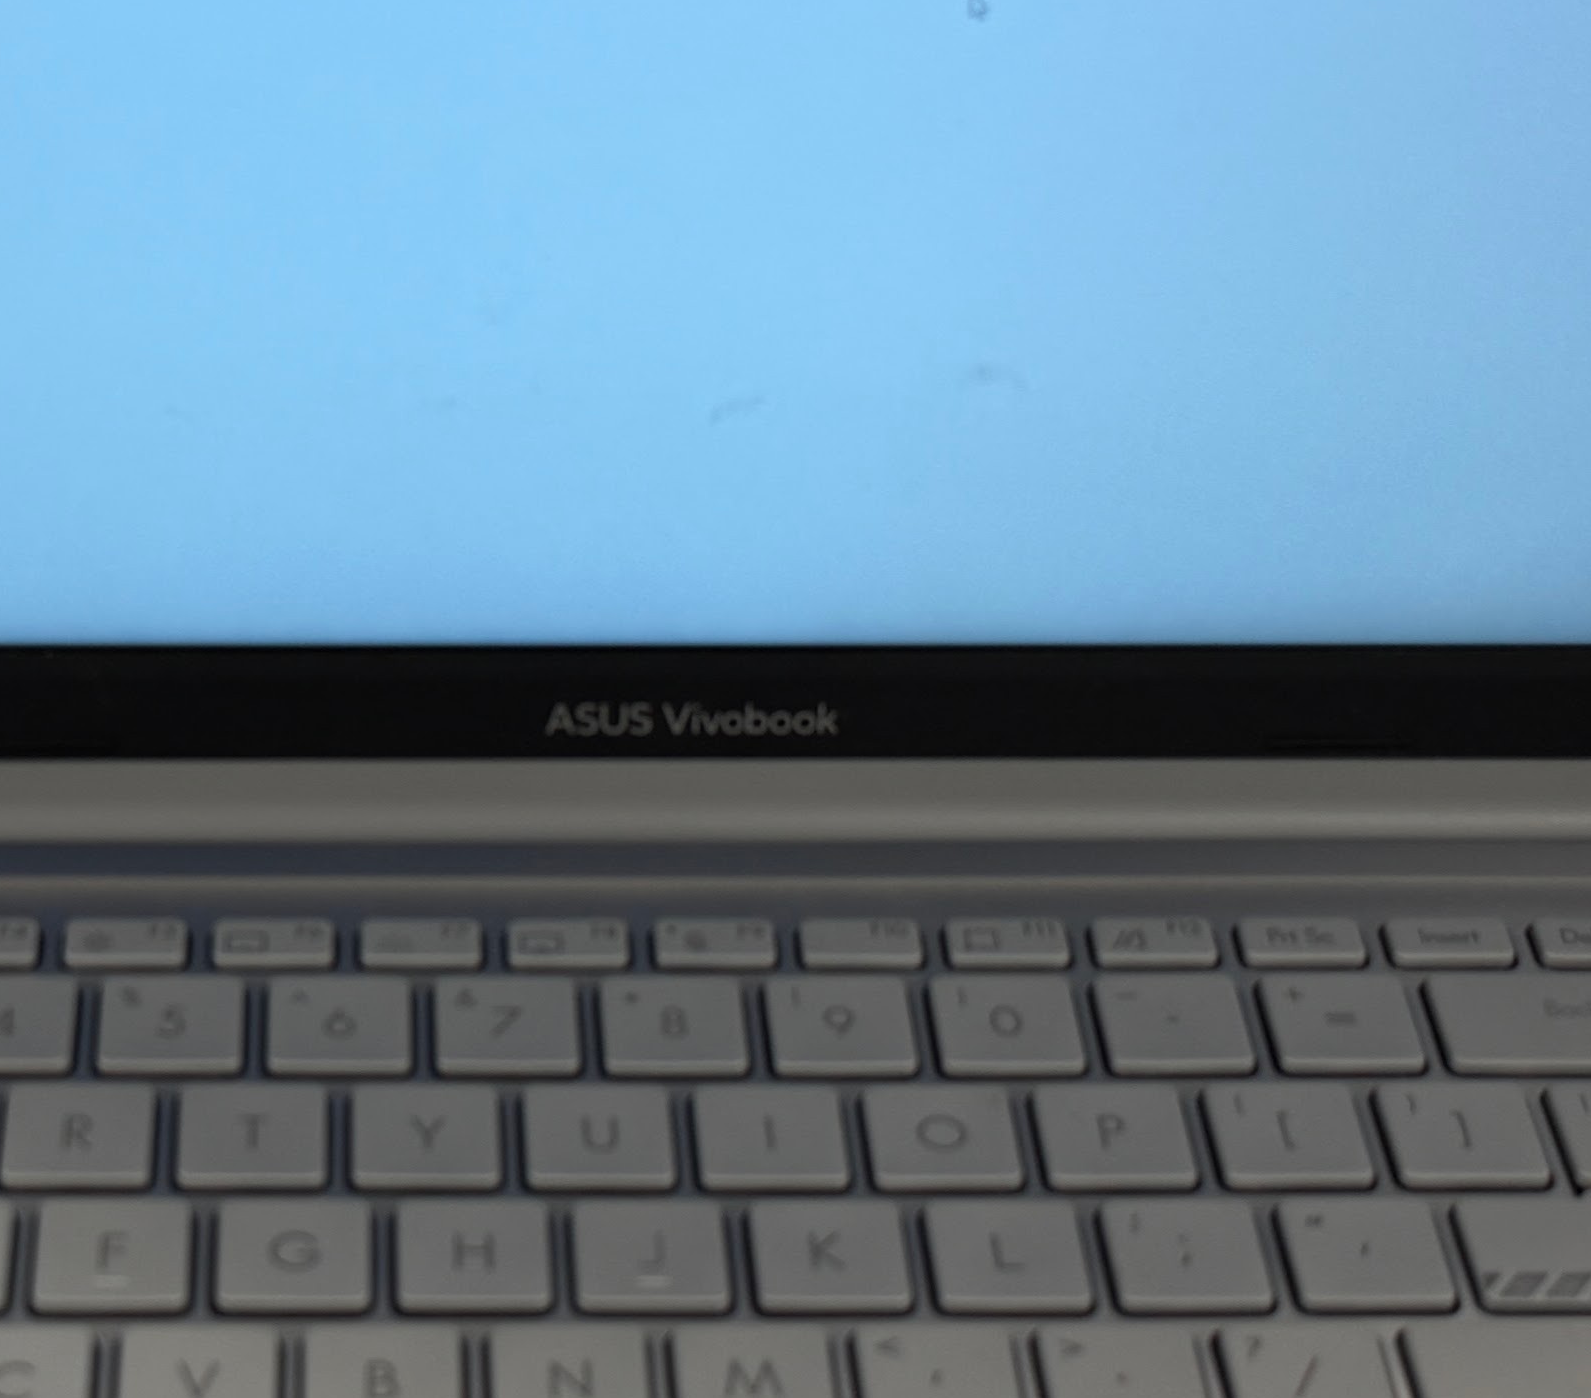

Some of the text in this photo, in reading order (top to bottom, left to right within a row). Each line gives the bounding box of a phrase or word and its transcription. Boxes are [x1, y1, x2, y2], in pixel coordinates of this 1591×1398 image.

[545, 702, 838, 737] ASUS Vivobook
[1418, 927, 1482, 946] Insert
[156, 1006, 187, 1039] 5
[322, 1007, 358, 1040] 6
[492, 1006, 522, 1038] 7
[658, 1006, 688, 1039] 8
[822, 1005, 856, 1038] 9
[62, 1113, 95, 1152] R
[237, 1113, 268, 1152] T
[411, 1113, 447, 1151] Y
[580, 1113, 620, 1153] U
[915, 1112, 969, 1153] O
[1096, 1112, 1126, 1150] P
[94, 1230, 128, 1272] F
[266, 1229, 323, 1273] G
[449, 1231, 497, 1273] H
[636, 1230, 667, 1273] J
[807, 1229, 849, 1273] K
[989, 1231, 1026, 1273] L
